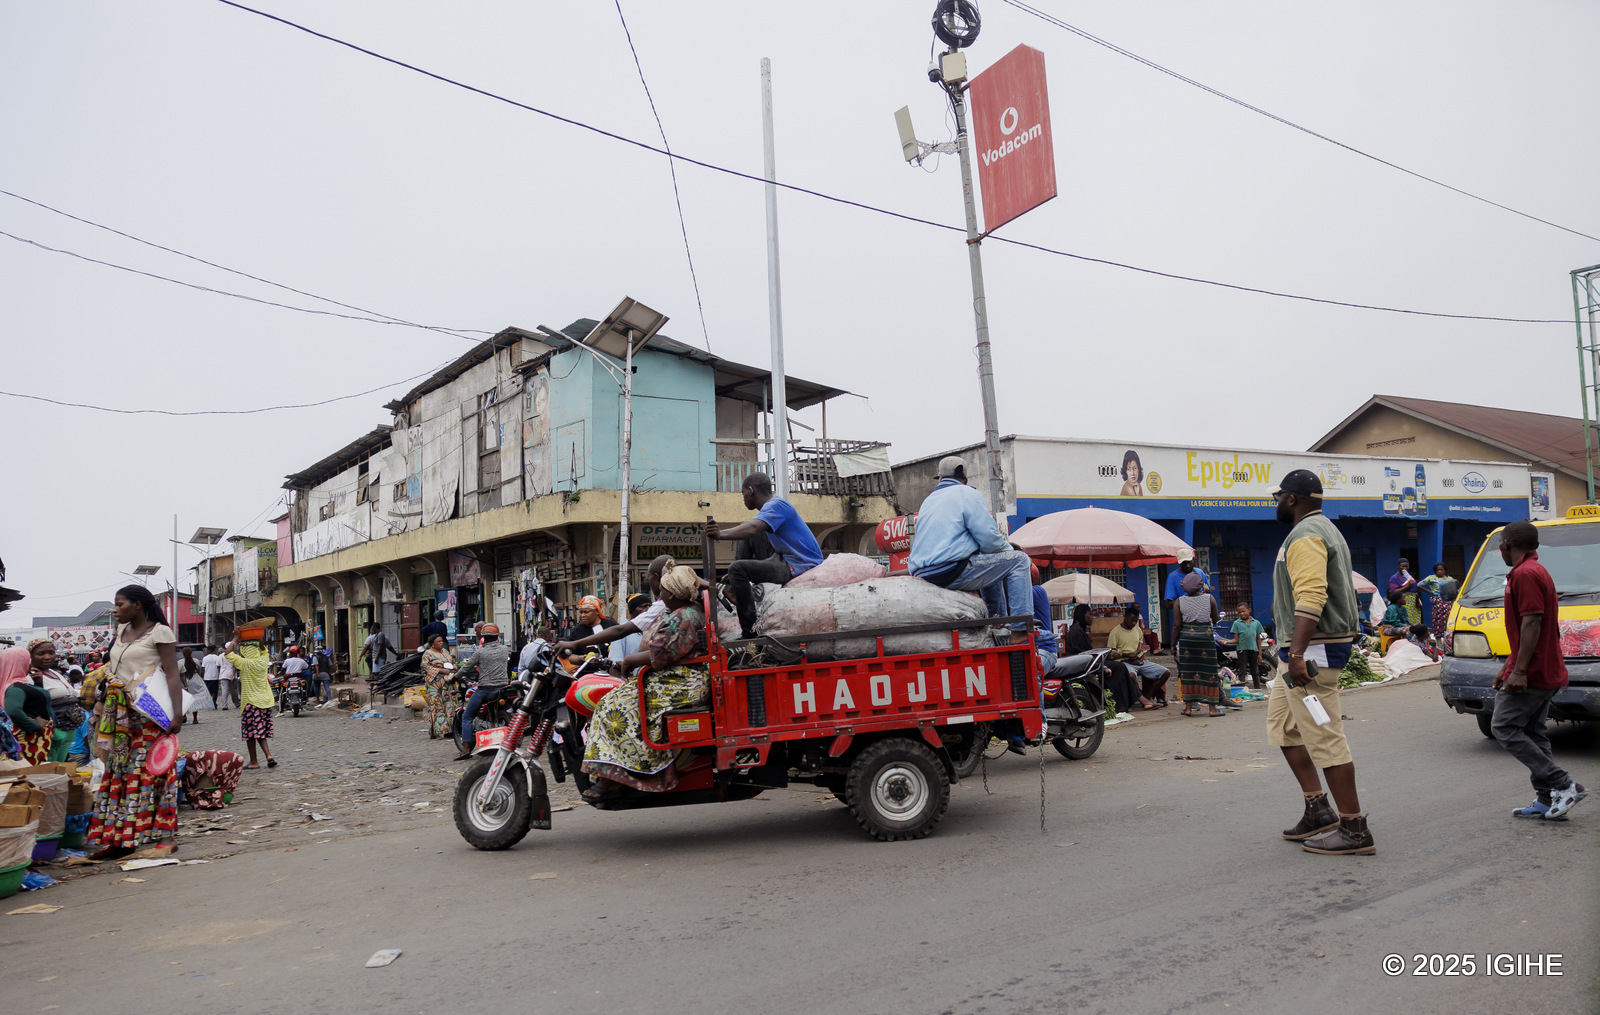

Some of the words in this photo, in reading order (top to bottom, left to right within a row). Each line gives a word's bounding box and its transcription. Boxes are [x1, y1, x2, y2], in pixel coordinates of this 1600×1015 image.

[982, 123, 1042, 166] Vodacom
[1186, 452, 1271, 489] Epiglow
[1464, 477, 1485, 488] Shalina
[640, 535, 701, 544] PHARMACEU
[891, 538, 911, 550] DIREC
[1147, 563, 1160, 630] FFICINE
[793, 665, 987, 714] HAOJIN
